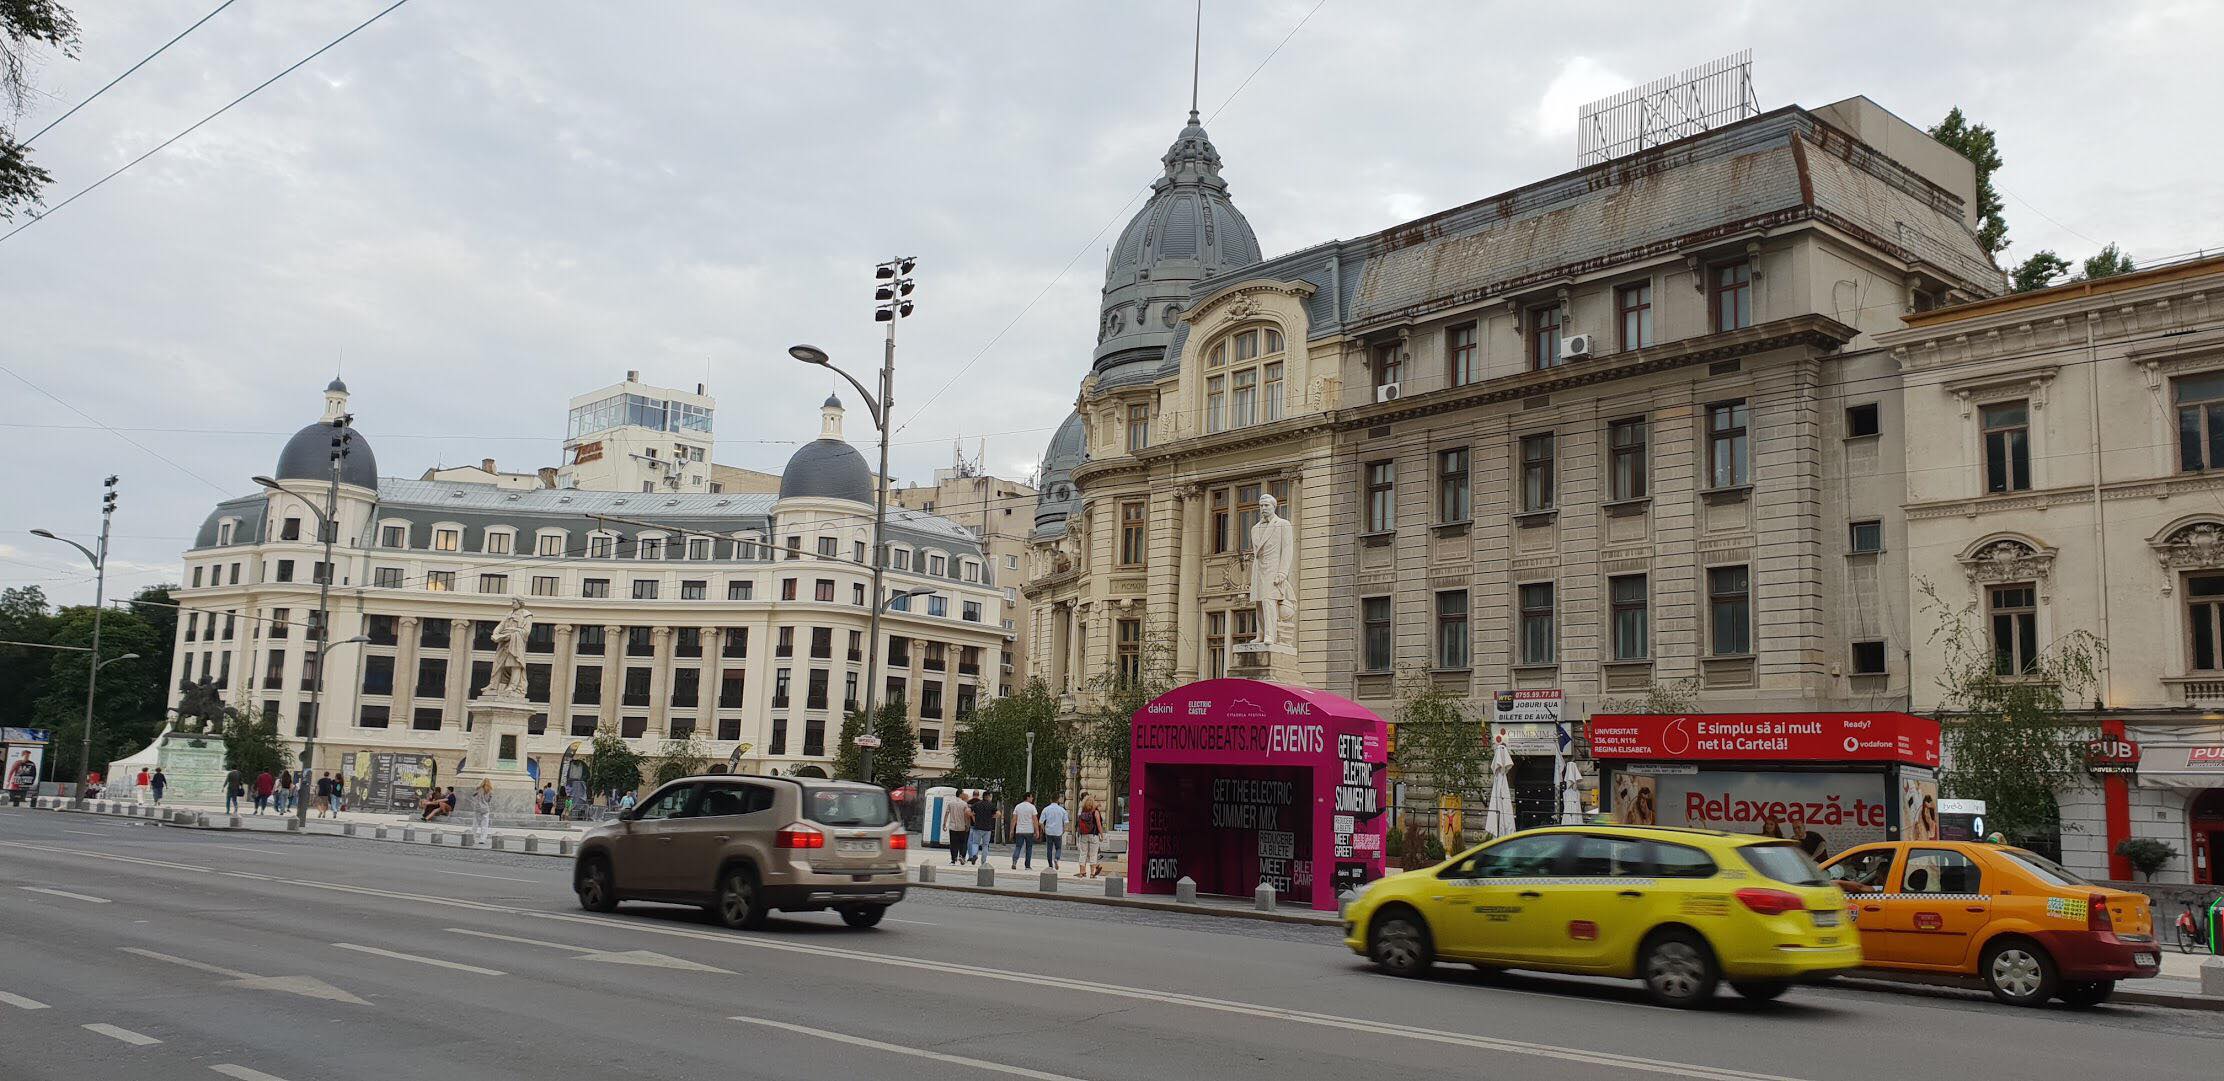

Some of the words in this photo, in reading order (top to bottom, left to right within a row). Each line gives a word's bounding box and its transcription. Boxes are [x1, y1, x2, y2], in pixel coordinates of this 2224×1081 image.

[1148, 702, 1173, 714] dakini
[1697, 722, 1706, 734] E
[1708, 721, 1753, 737] simplu
[1756, 721, 1771, 734] să
[1774, 722, 1786, 734] ai
[1788, 722, 1822, 734] mult
[1843, 720, 1871, 729] Ready?
[1337, 733, 1350, 759] GET
[1351, 735, 1363, 760] THE
[1618, 746, 1652, 754] ELISABETA
[1697, 739, 1719, 750] net
[1721, 738, 1734, 750] la
[1736, 738, 1788, 750] Cartelă!
[1859, 740, 1893, 748] vodafone
[2089, 741, 2133, 758] PUB
[1343, 760, 1372, 787] ELECTRIC
[1213, 779, 1230, 801] GET
[1232, 780, 1249, 803] THE
[1250, 780, 1293, 806] ELECTRIC
[1335, 786, 1364, 812] SUMMER
[1365, 788, 1377, 813] MIX
[1212, 803, 1257, 829] SUMMER
[1259, 806, 1278, 830] MIX
[1685, 791, 1885, 827] Relaxează-te
[1260, 832, 1293, 846] REDUCERE
[1334, 833, 1350, 845] MEET
[1260, 844, 1268, 856] LA
[1268, 845, 1290, 857] BILETE
[1334, 845, 1353, 857] GREET
[1146, 858, 1178, 884] /EVENTS
[1260, 858, 1287, 875] MEET
